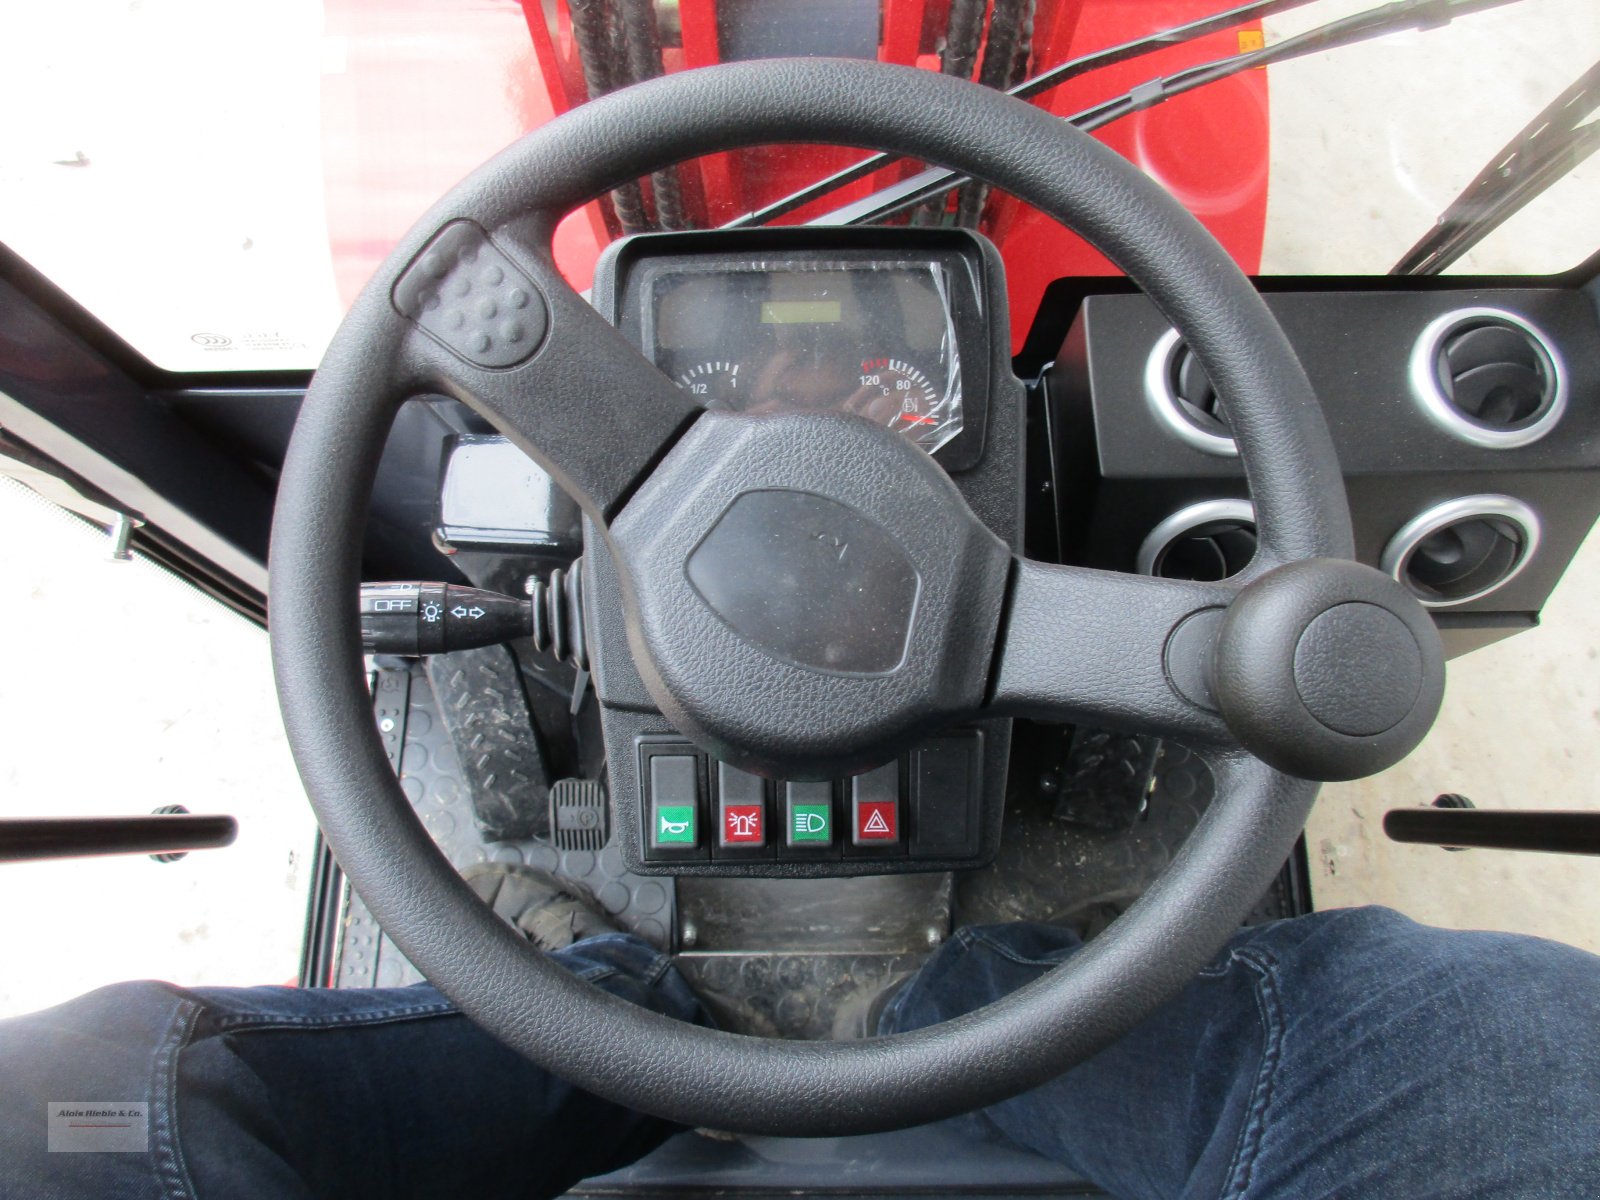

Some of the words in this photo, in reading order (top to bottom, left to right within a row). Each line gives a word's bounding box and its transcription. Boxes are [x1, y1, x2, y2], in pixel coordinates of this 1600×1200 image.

[730, 377, 737, 388] 1
[859, 375, 880, 386] 120
[896, 380, 911, 390] 80
[690, 383, 708, 394] 1/2
[374, 600, 412, 611] OFF
